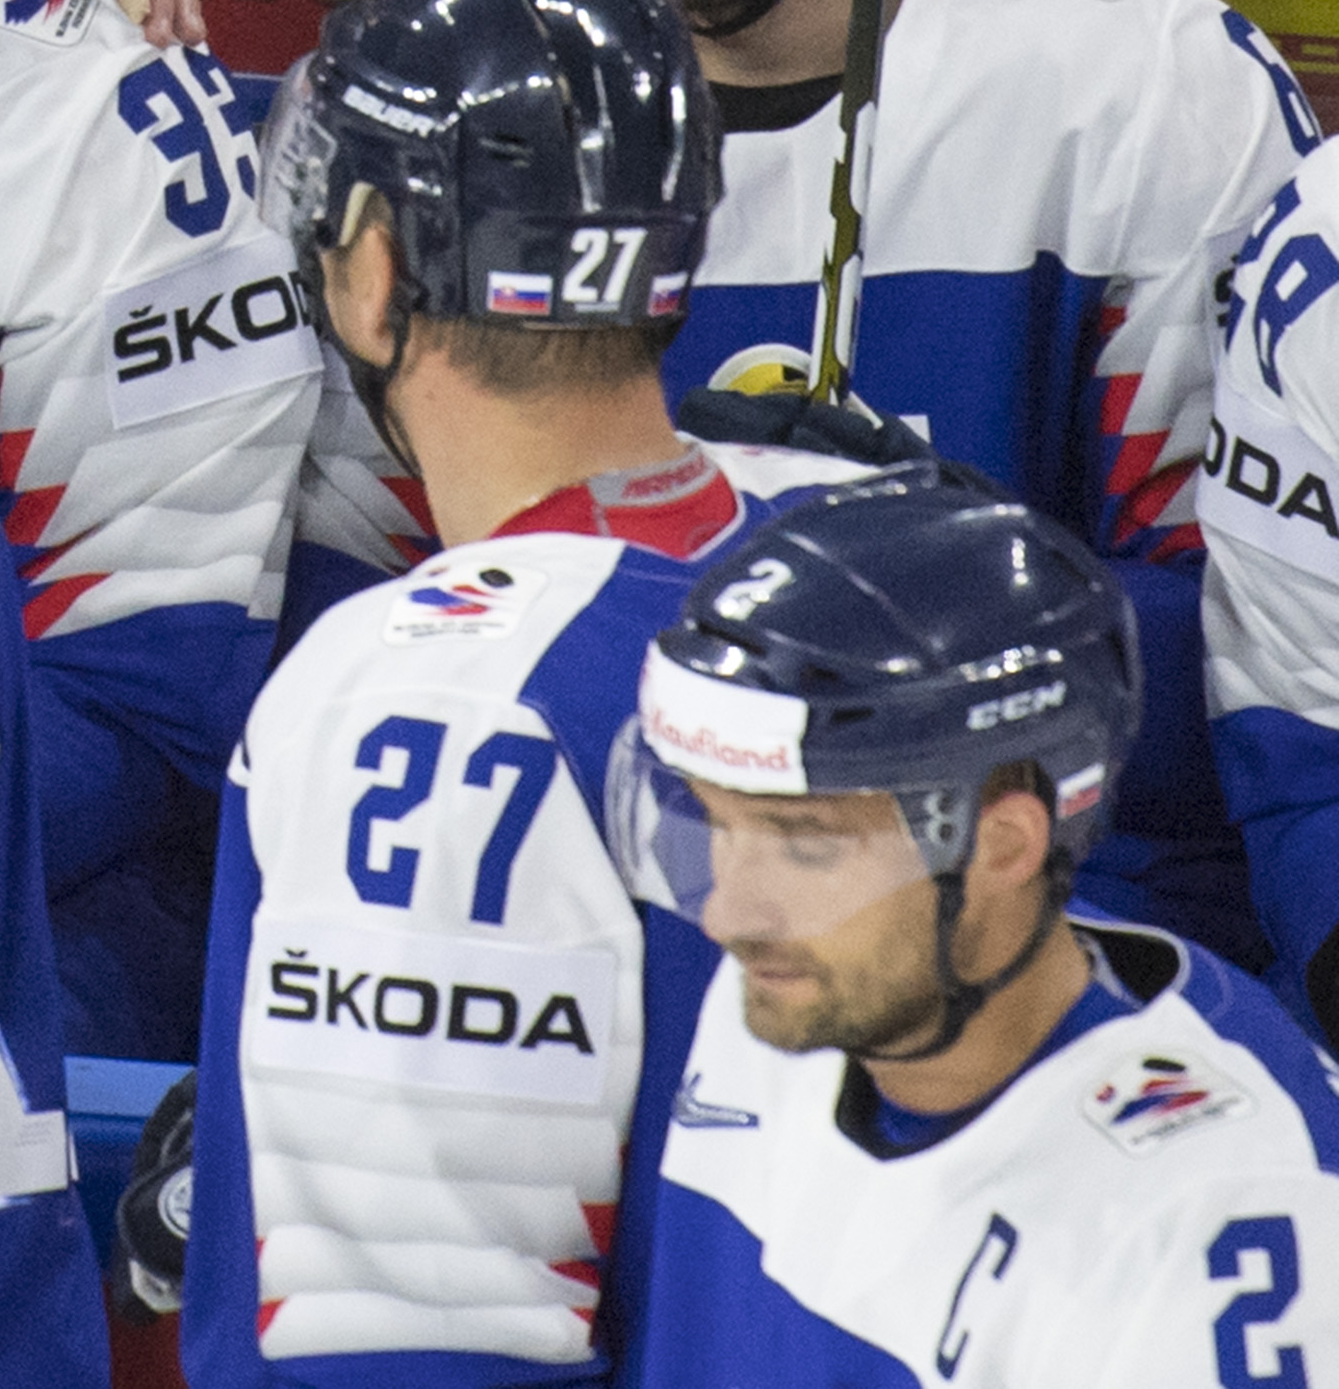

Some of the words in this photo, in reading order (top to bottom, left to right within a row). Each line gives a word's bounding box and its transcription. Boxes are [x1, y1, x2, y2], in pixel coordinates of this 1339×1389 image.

[117, 42, 256, 238] 33
[344, 84, 436, 139] BAUER
[561, 227, 649, 304] 27
[713, 560, 793, 620] 2
[968, 681, 1067, 731] CCM
[346, 714, 559, 927] 27
[267, 949, 596, 1057] ŠKODA
[935, 1212, 1019, 1380] C
[1206, 1215, 1309, 1389] 2
